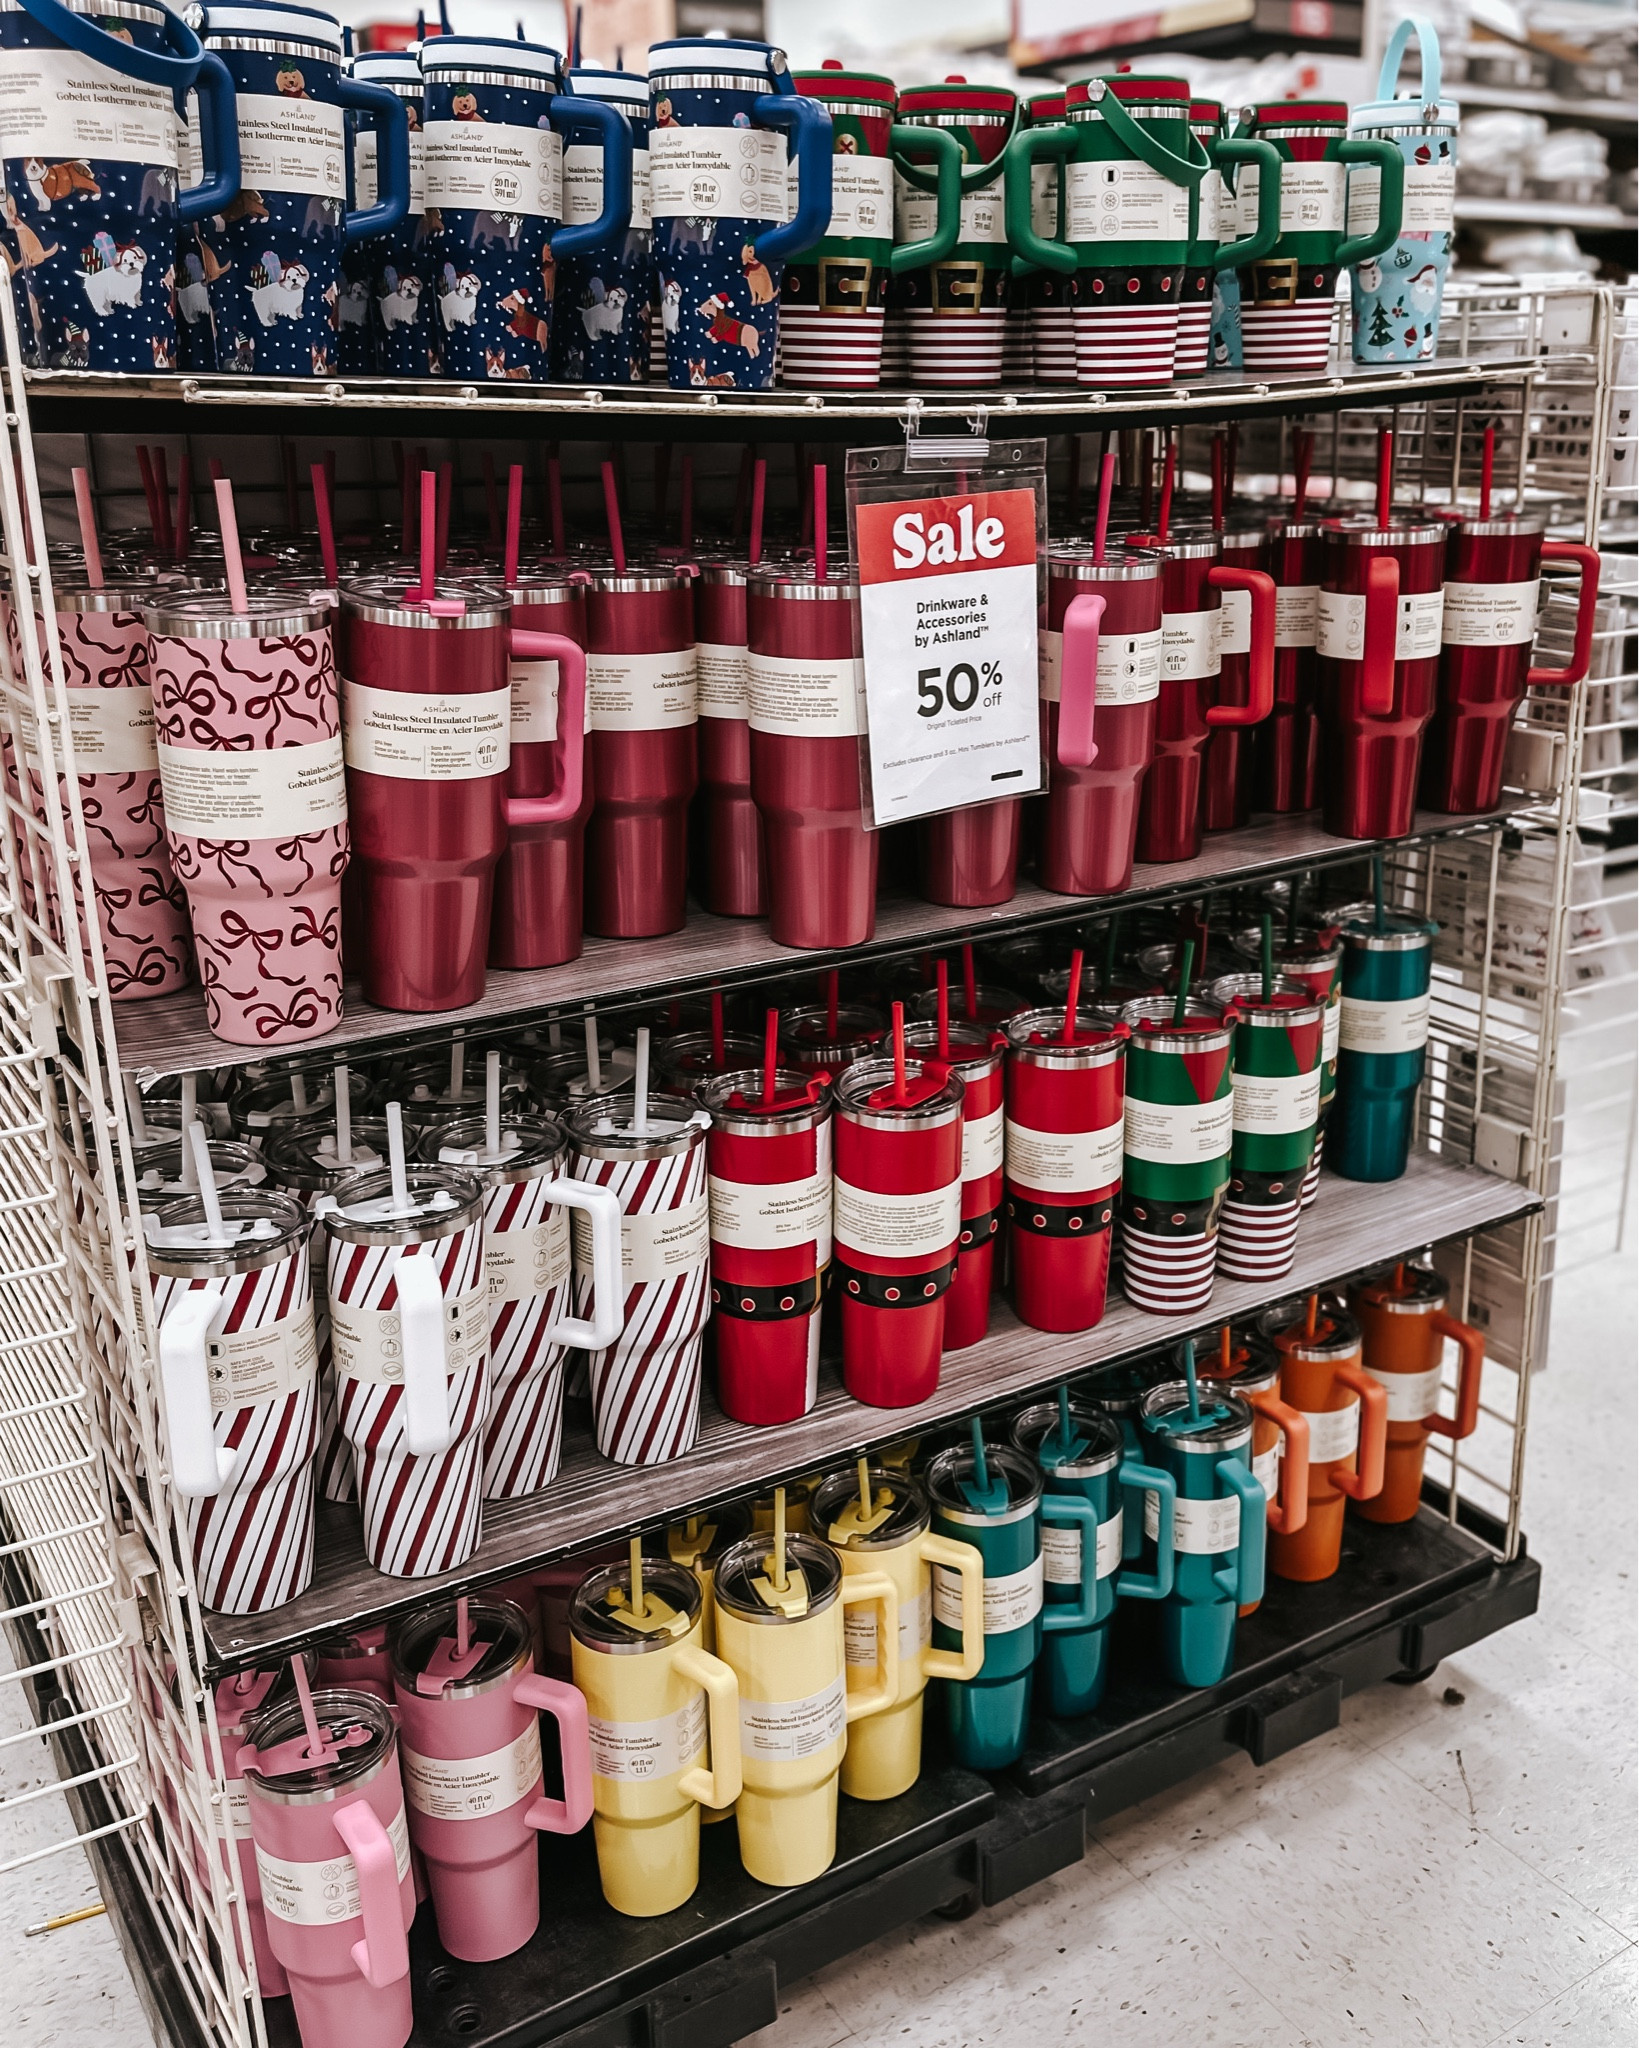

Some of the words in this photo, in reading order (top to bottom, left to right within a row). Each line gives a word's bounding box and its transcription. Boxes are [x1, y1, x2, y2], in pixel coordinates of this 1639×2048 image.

[68, 80, 108, 90] Stainless
[110, 83, 130, 93] Steel
[57, 92, 90, 102] Gobelet
[94, 94, 137, 106] Isotherme
[238, 120, 269, 128] tainless
[271, 122, 290, 130] Steel
[292, 123, 322, 134] Insulated
[255, 131, 296, 142] Isotherme
[308, 137, 324, 145] Acier
[459, 145, 491, 153] Insulated
[493, 146, 523, 156] Tumbler
[494, 157, 531, 167] Inoxydable
[693, 163, 731, 172] Inoxydable
[494, 178, 503, 187] 20
[892, 504, 1005, 570] Sale
[917, 597, 976, 614] Drinkware
[980, 594, 988, 605] &
[916, 612, 986, 630] Accessories
[915, 635, 929, 648] by
[983, 692, 1002, 707] off
[372, 710, 408, 722] Stainless
[410, 715, 431, 724] Steel
[434, 716, 471, 724] Insulated
[473, 713, 499, 722] Tumbler
[927, 721, 946, 730] Original
[948, 717, 968, 728] Ticketed
[364, 719, 391, 730] Gobelet
[394, 723, 437, 734] Isotherme
[453, 726, 472, 734] Acier
[883, 760, 906, 769] Excludes
[908, 755, 932, 764] clearance
[971, 742, 995, 751] Tumblers
[298, 765, 328, 778] Stainless
[288, 778, 317, 790] Gobelet
[768, 1199, 798, 1207] Stainless
[759, 1208, 784, 1216] Gobelet
[624, 1735, 653, 1744] Tumbler
[429, 1772, 459, 1782] Insulated
[461, 1771, 490, 1781] Tumbler
[462, 1775, 500, 1789] Inoxydable
